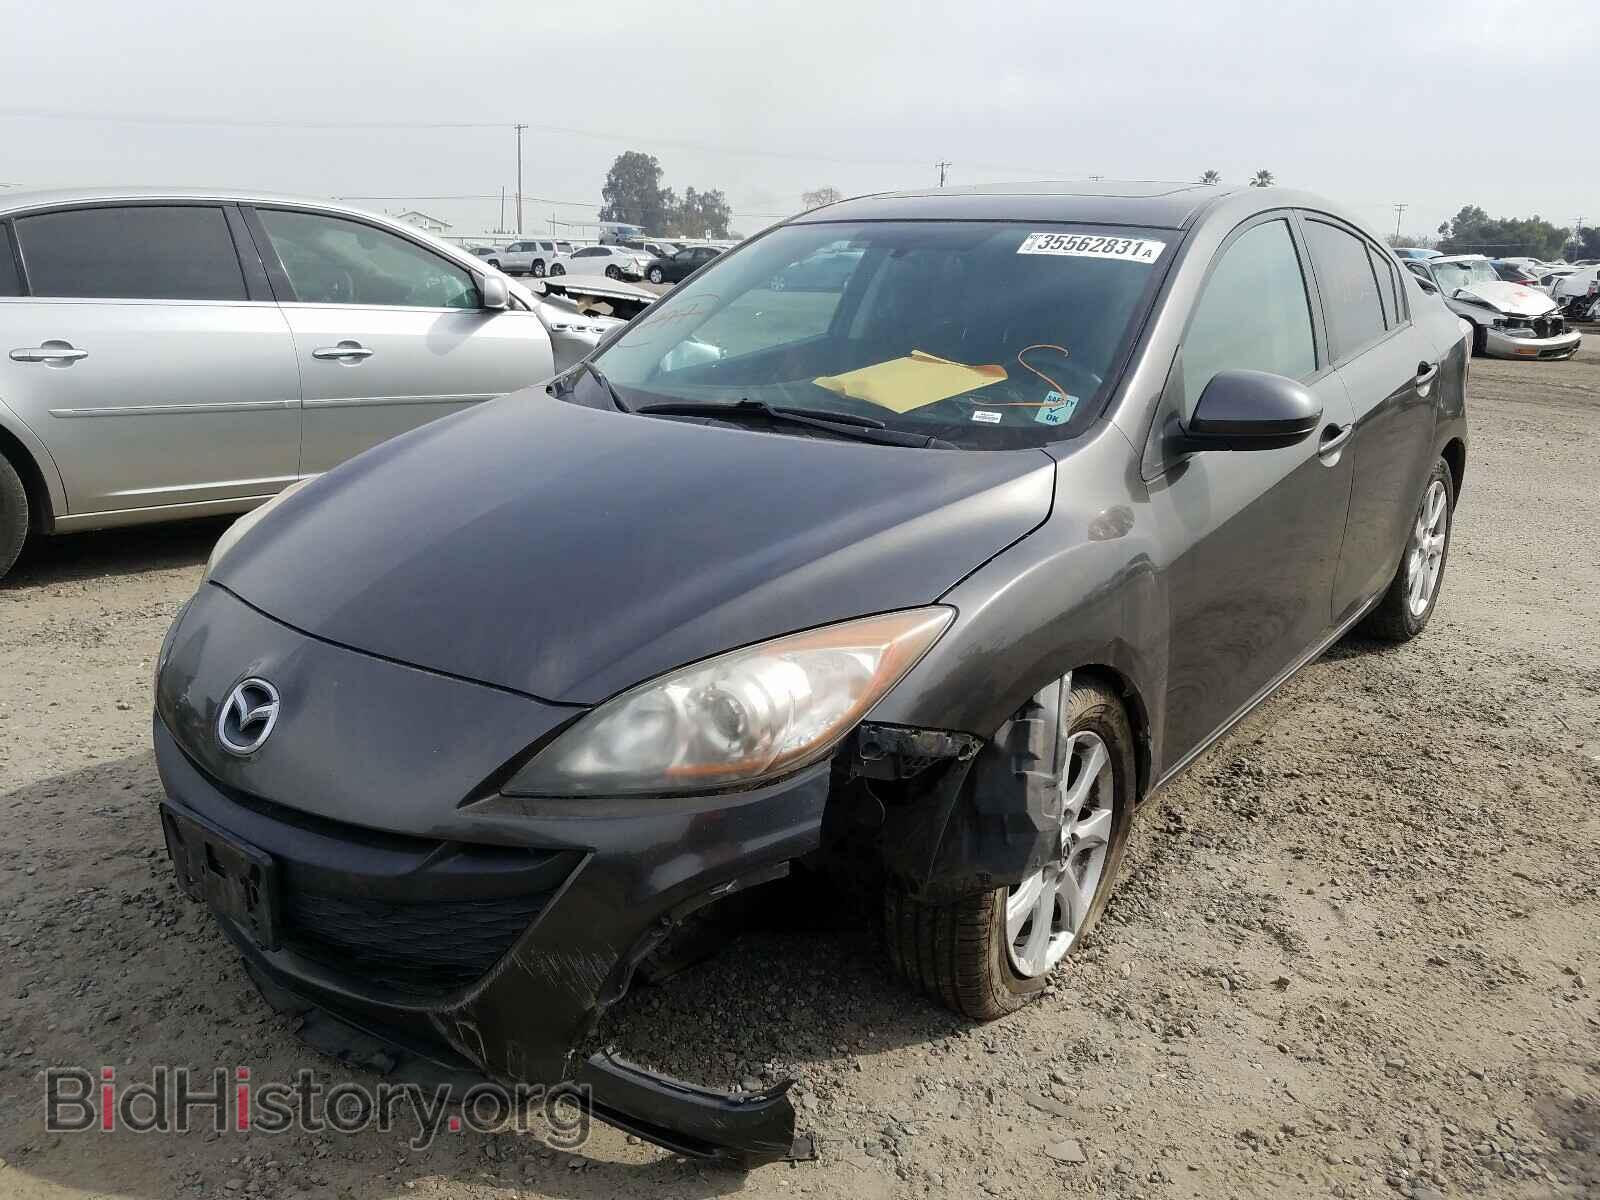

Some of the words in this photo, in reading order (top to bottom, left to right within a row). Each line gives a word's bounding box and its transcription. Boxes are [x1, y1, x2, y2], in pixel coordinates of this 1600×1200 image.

[1037, 234, 1144, 256] 35562831
[1142, 249, 1152, 258] A
[1045, 414, 1059, 422] OK
